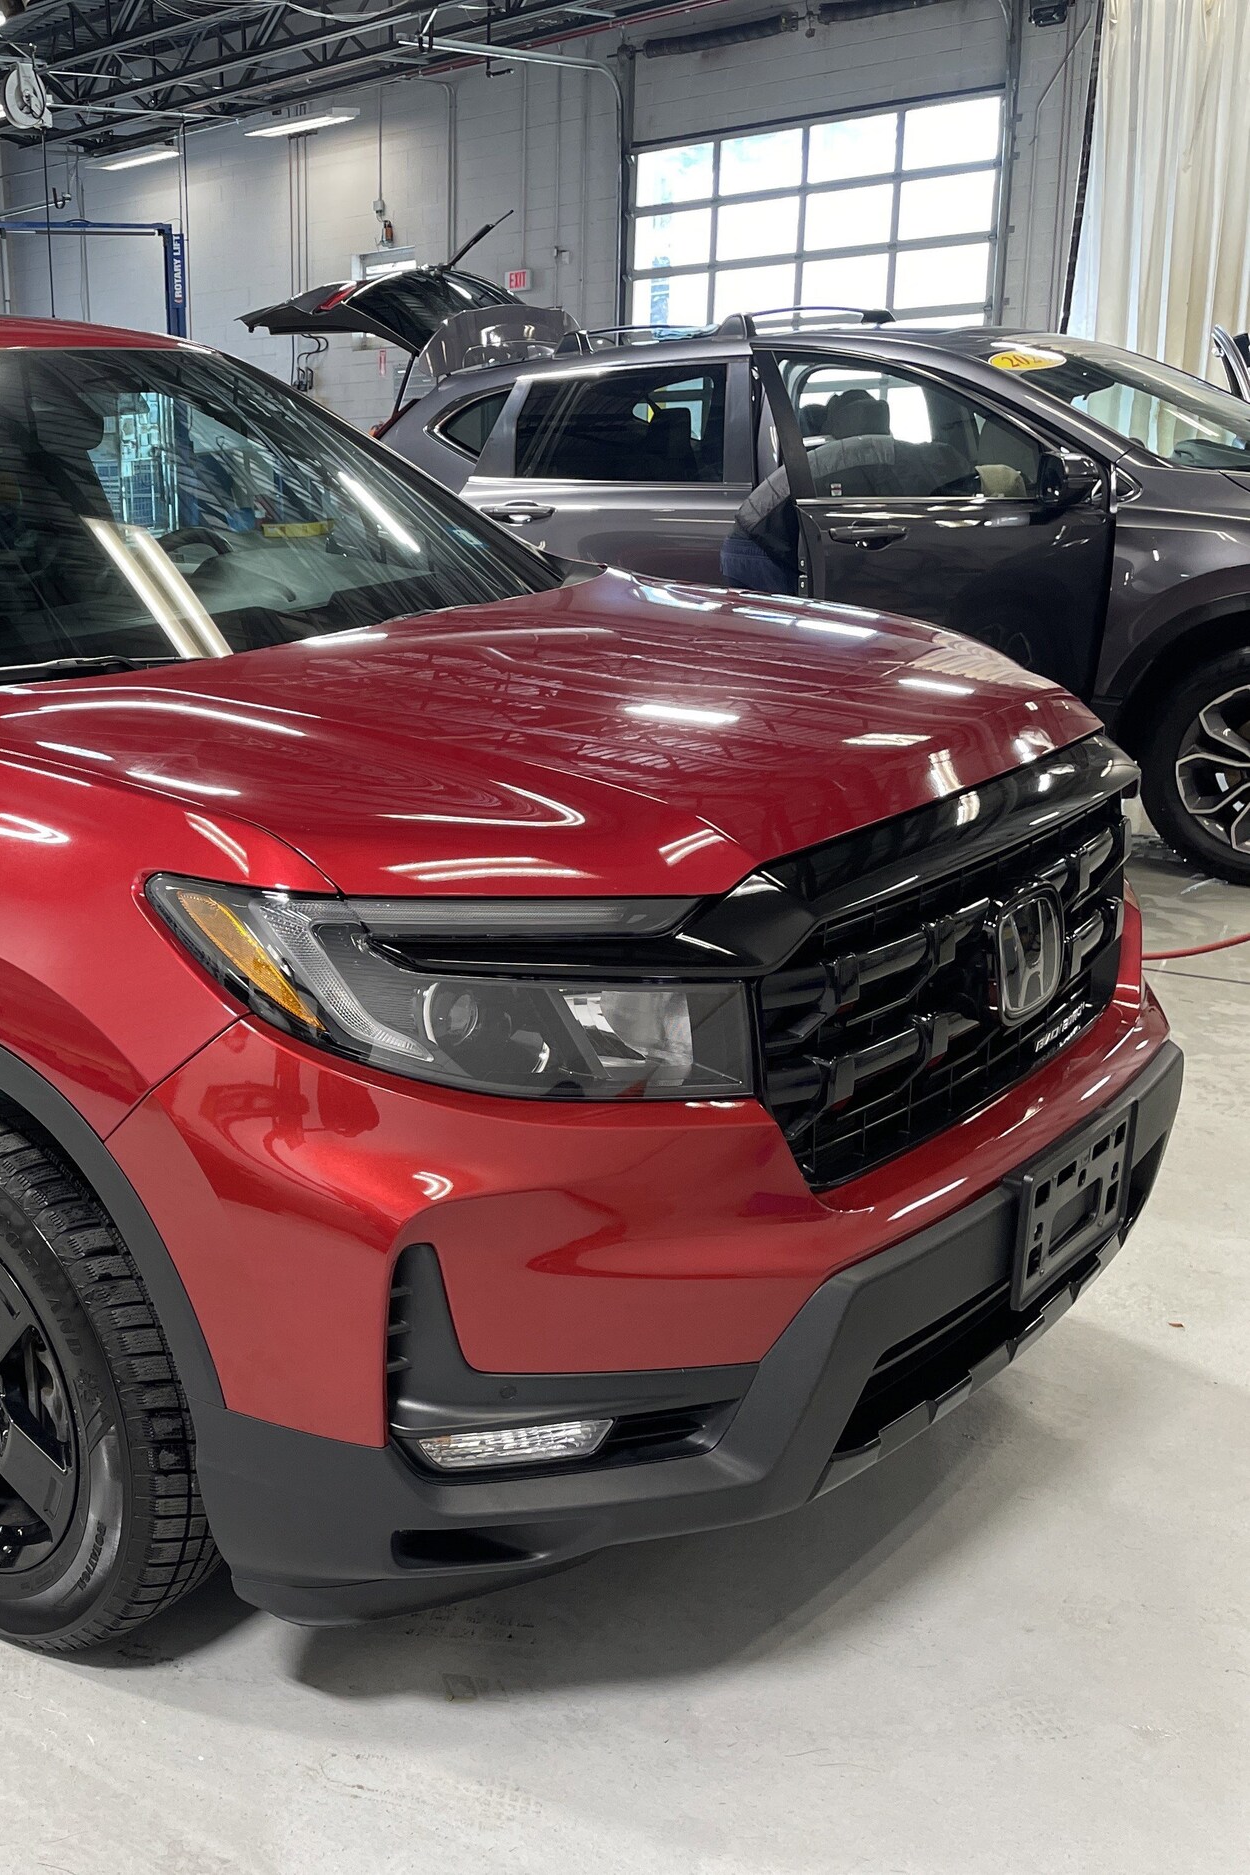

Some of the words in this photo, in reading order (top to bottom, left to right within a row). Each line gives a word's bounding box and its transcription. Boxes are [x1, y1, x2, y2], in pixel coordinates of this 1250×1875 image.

[172, 234, 182, 255] LIFT
[173, 258, 183, 298] ROTARY
[509, 271, 526, 289] EXIT
